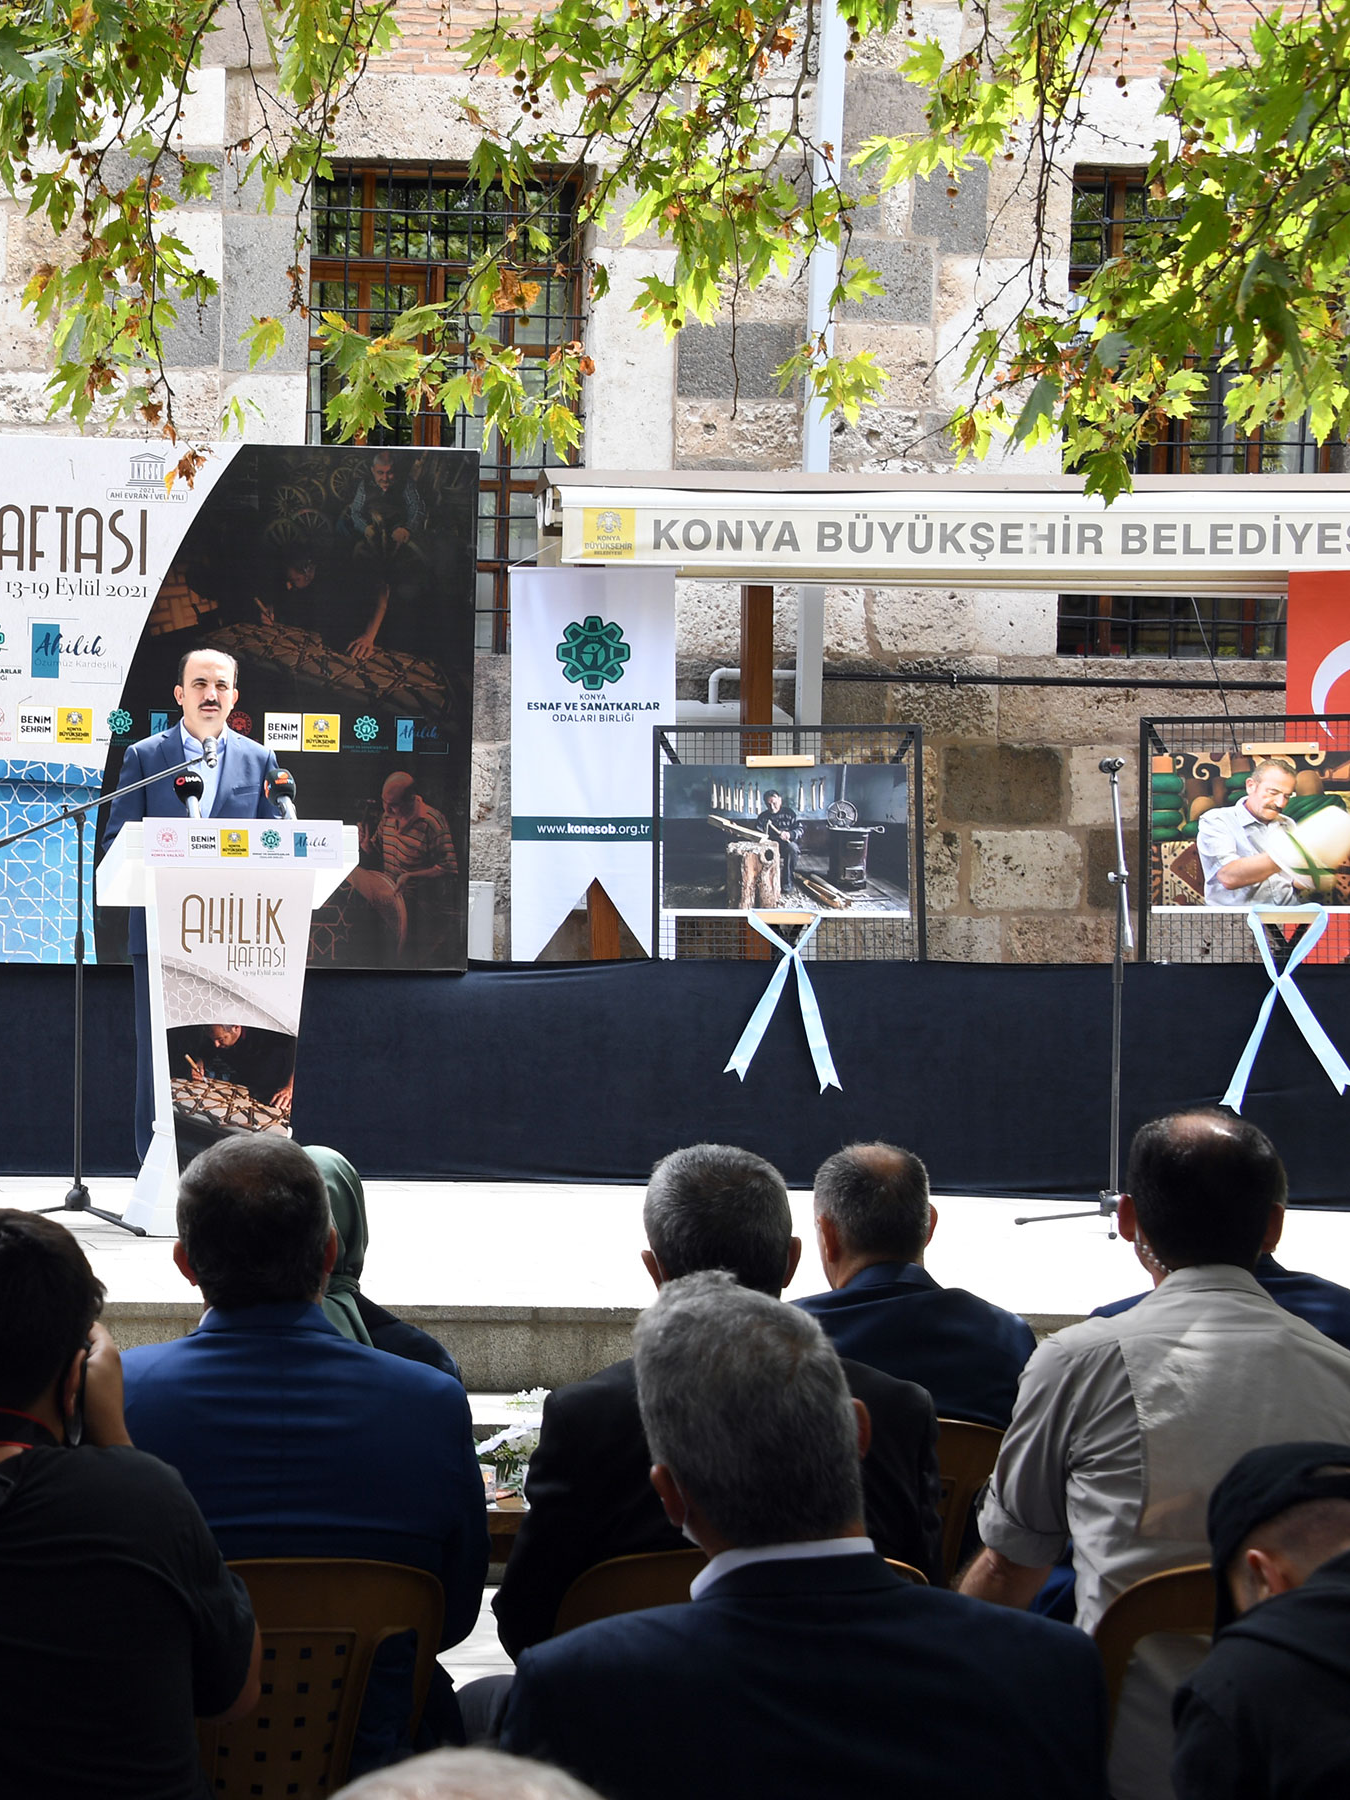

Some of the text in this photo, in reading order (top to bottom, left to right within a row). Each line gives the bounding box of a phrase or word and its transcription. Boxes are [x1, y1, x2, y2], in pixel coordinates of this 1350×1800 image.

[652, 512, 1350, 562] KONYA BÜYÜKŞEHİR BELEDİYE
[4, 577, 149, 601] 13-19 Eylül 2021
[35, 632, 107, 657] Ahilik
[527, 702, 660, 711] ESNAF VE SANATKARLAR
[579, 693, 607, 701] KONYA
[552, 714, 596, 722] ODALARI
[536, 822, 650, 836] www.konesob.org.tr
[181, 893, 285, 953] AHİLİK
[228, 945, 286, 972] HAFTASI
